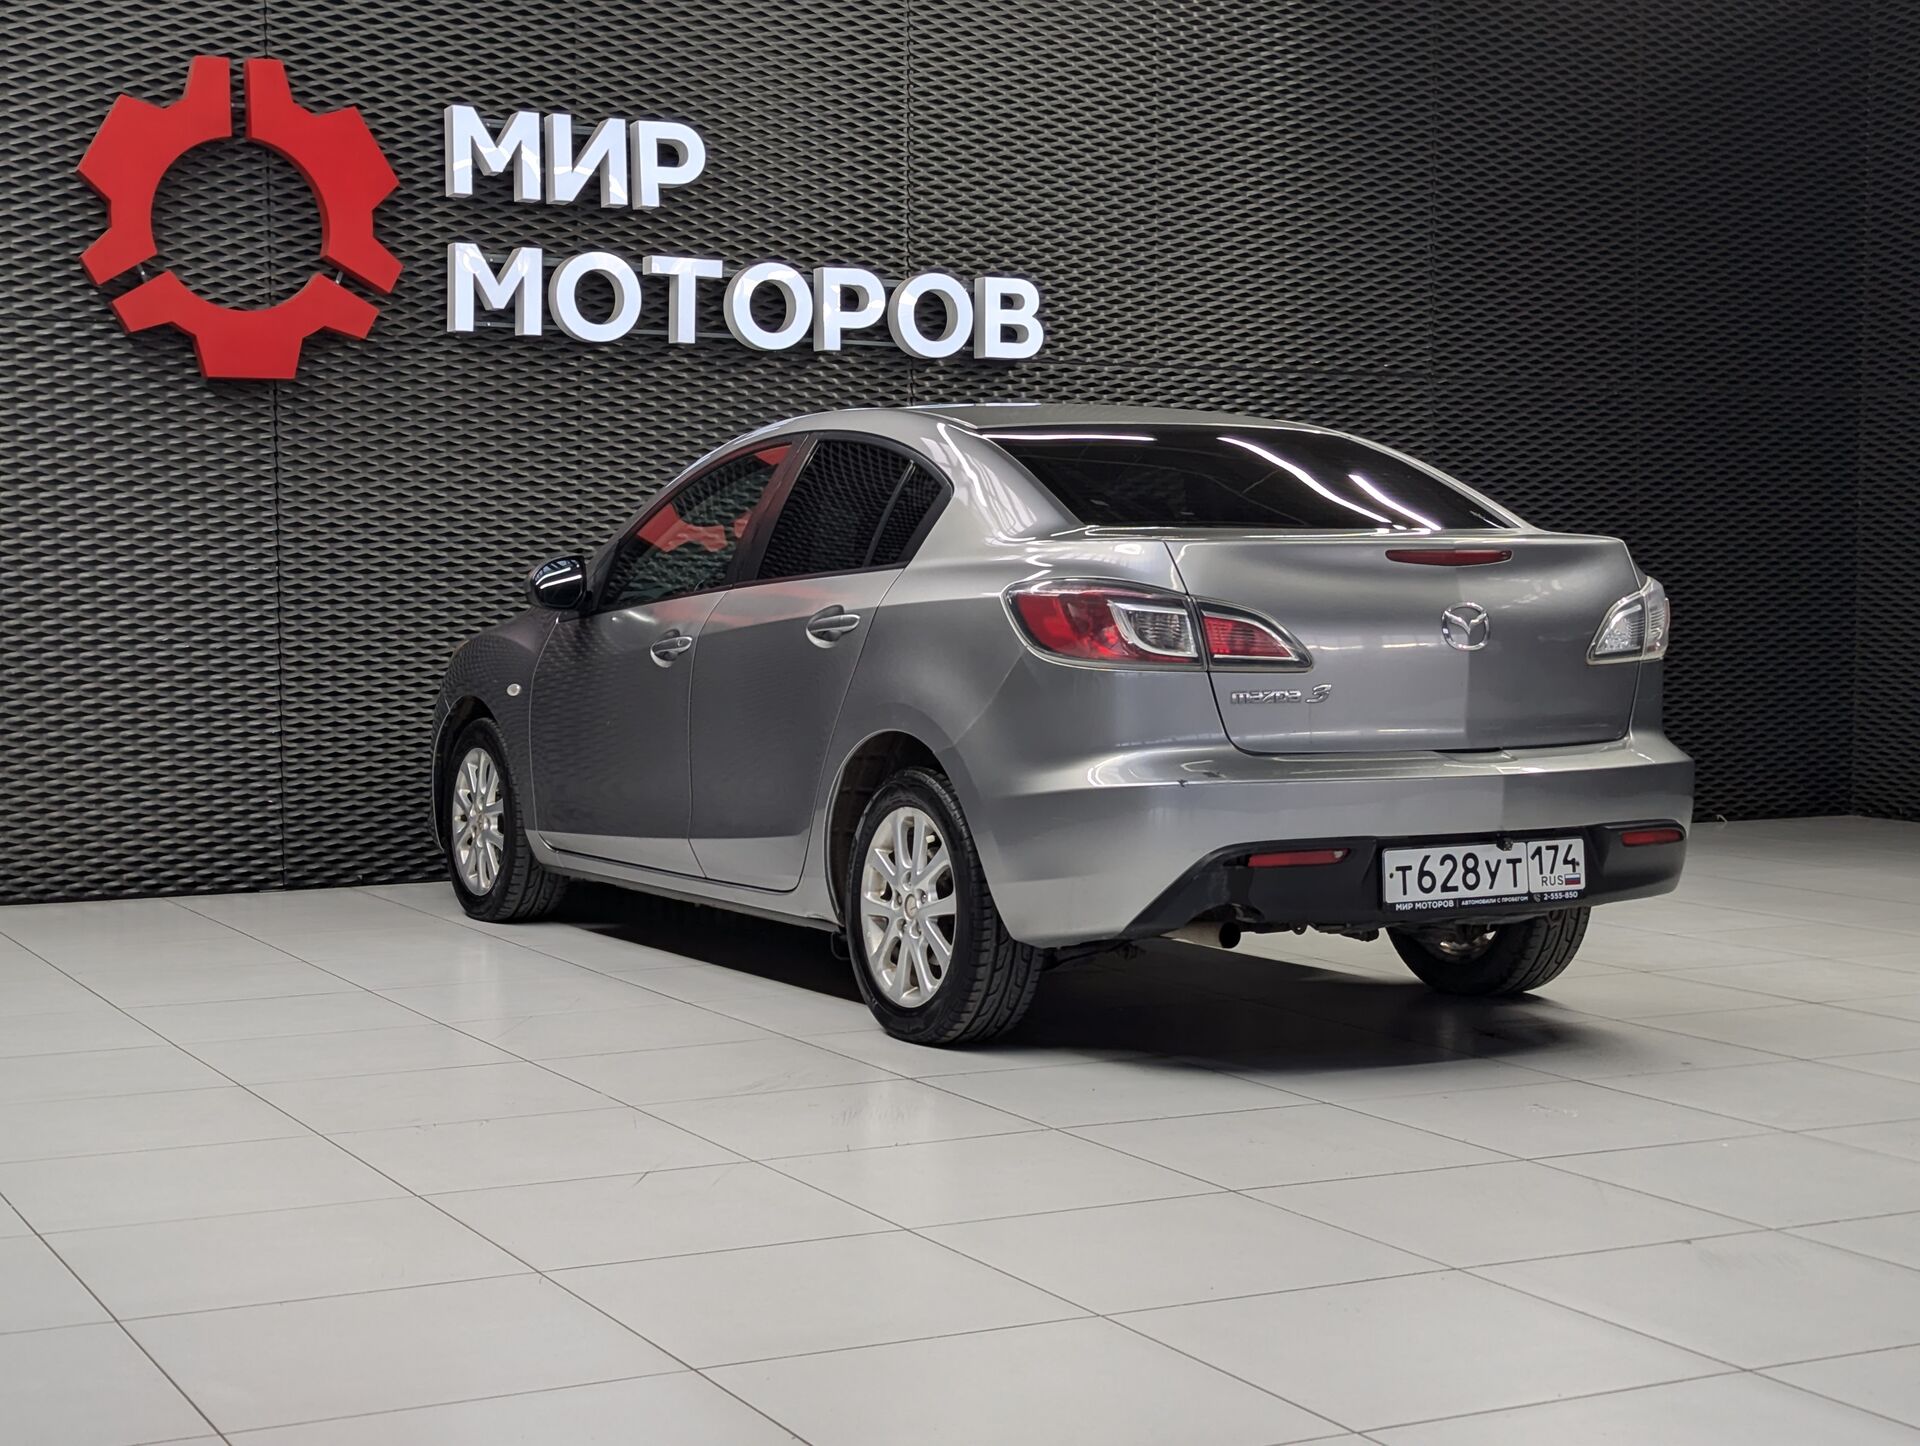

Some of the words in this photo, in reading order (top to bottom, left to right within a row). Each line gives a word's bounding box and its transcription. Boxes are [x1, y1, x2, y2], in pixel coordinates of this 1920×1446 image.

[444, 104, 706, 210] МИР
[446, 242, 1045, 360] МОТОРОВ
[1305, 683, 1332, 704] 3
[1530, 843, 1576, 876] 174
[1541, 875, 1564, 887] RUS
[1395, 902, 1413, 911] МИР
[1415, 899, 1455, 910] МОТОРОВ
[1461, 897, 1497, 906] АВТОМОБИЛИ
[1501, 895, 1529, 904] ПРОБЕГОМ
[1543, 890, 1579, 900] 2-555-850
